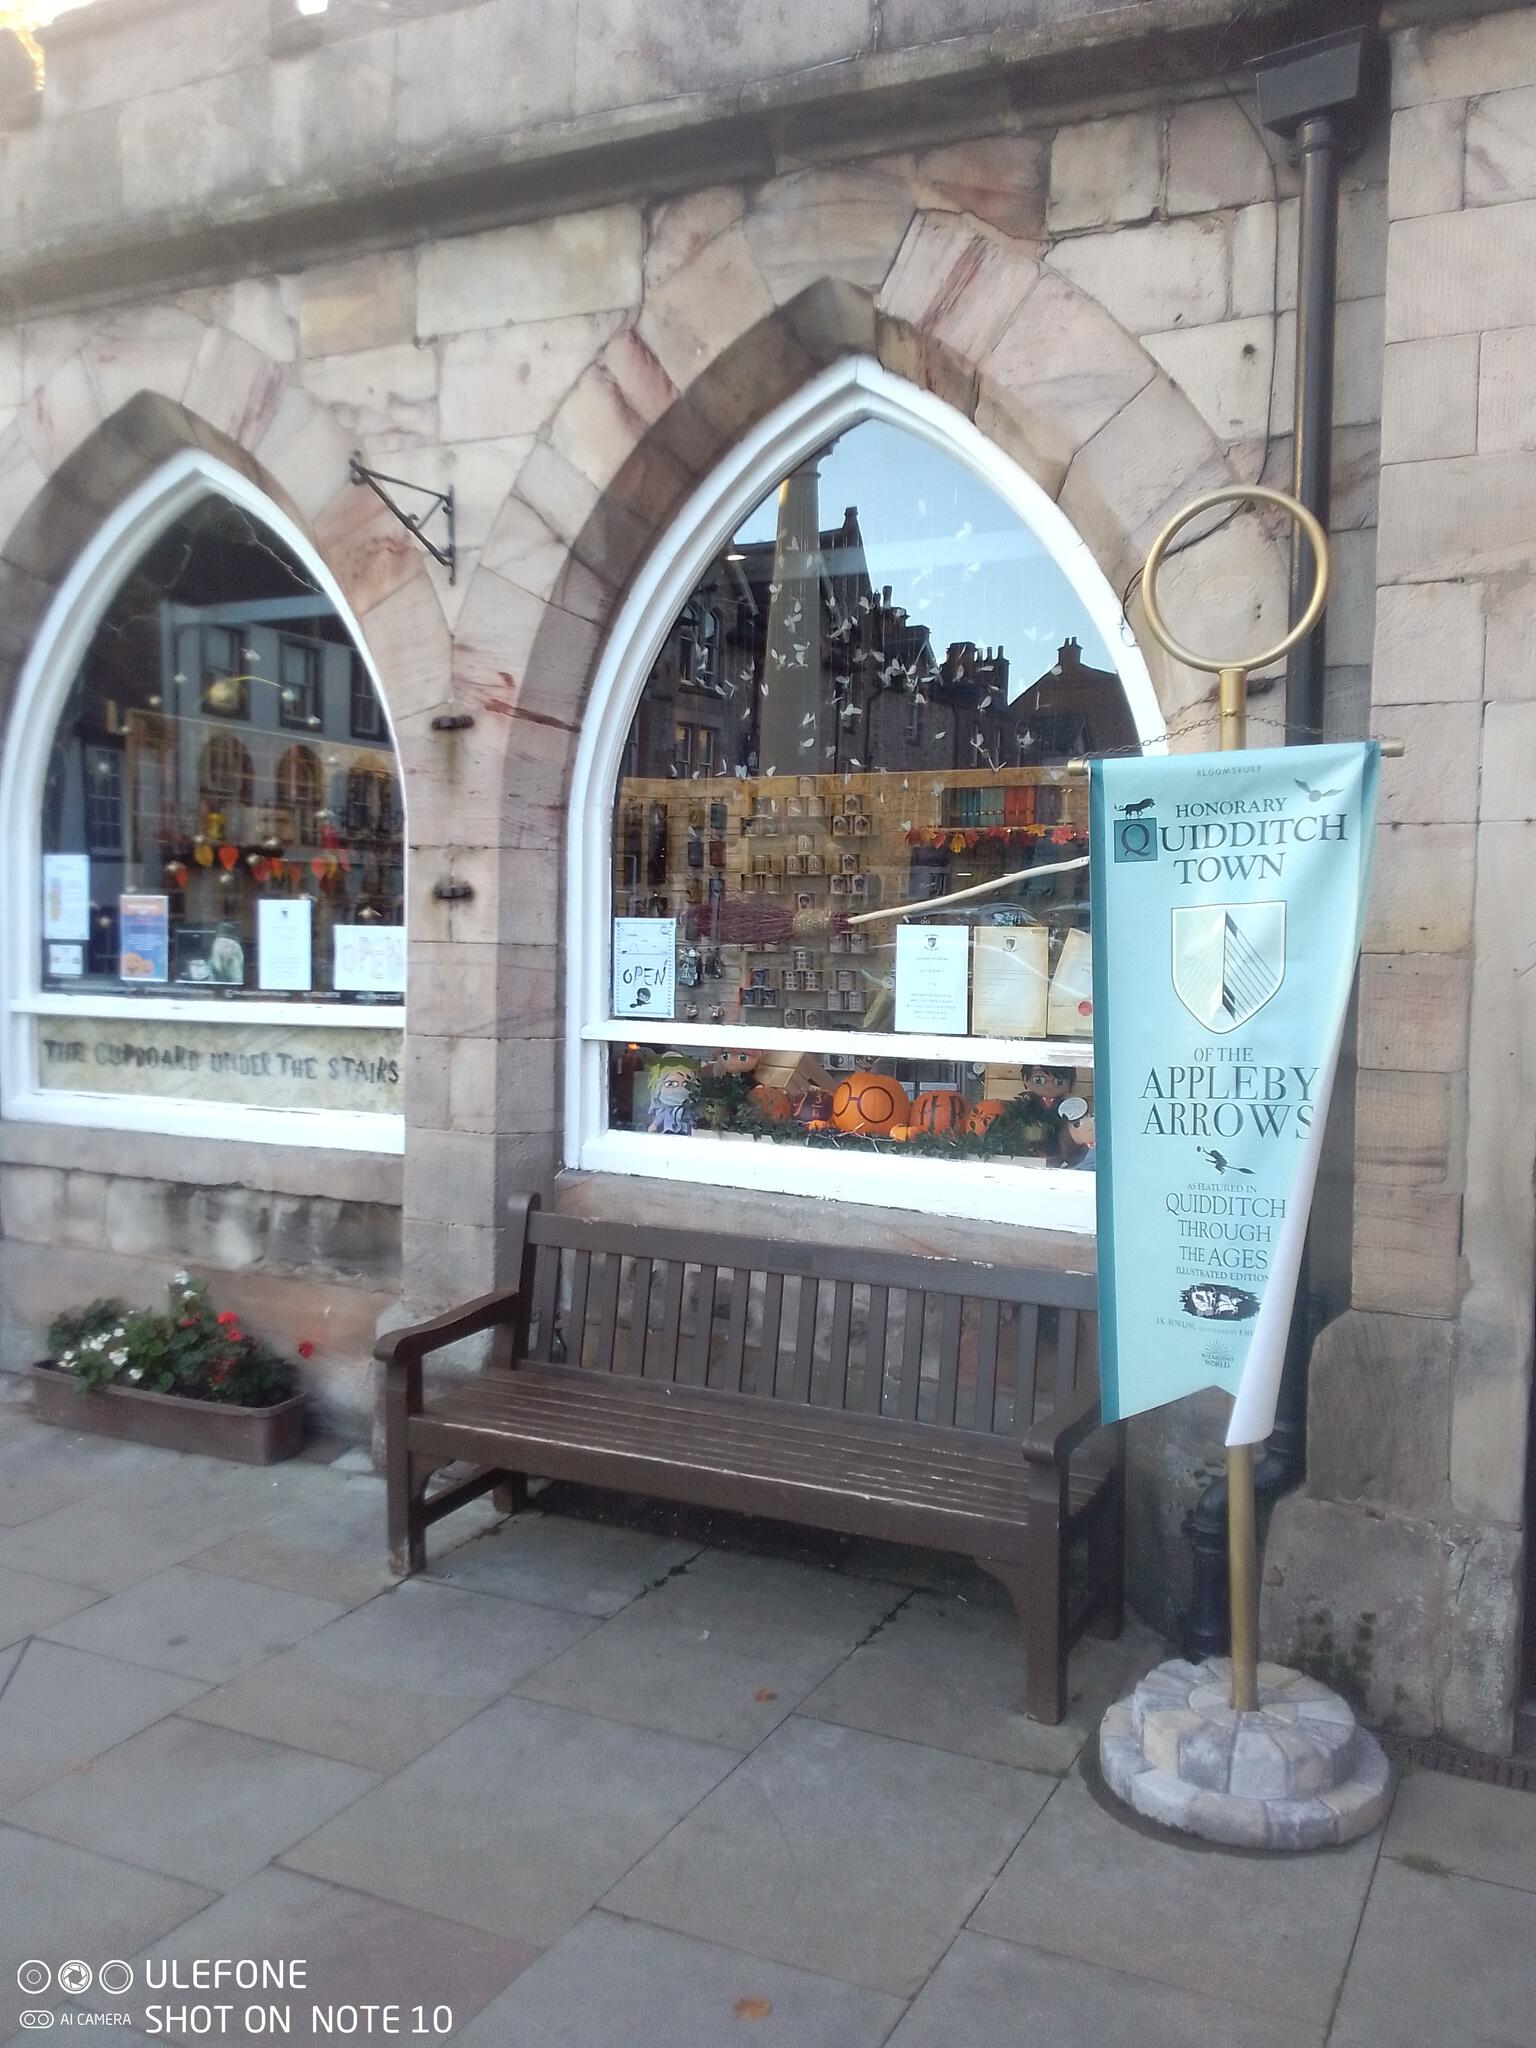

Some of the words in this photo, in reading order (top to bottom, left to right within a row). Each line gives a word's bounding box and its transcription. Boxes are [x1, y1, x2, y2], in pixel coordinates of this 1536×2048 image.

[1196, 765, 1262, 777] BLOOMSBURY
[1176, 797, 1288, 818] HONORARY
[1121, 813, 1349, 856] QUIDDITCH
[1173, 852, 1286, 885] TOWN
[622, 959, 668, 986] OPEN
[44, 1039, 86, 1063] THE
[210, 1051, 272, 1076] UNDER
[276, 1052, 318, 1080] THE
[328, 1055, 400, 1084] STAIRS
[1193, 1047, 1216, 1063] OF
[1217, 1047, 1254, 1062] THE
[1139, 1066, 1321, 1101] APPLEBY
[1141, 1102, 1314, 1140] ARROWS
[1197, 1183, 1244, 1193] FEATURED
[1246, 1185, 1258, 1193] IN
[1165, 1192, 1287, 1218] QUIDDITCH
[1177, 1219, 1272, 1243] THROUGH
[1179, 1245, 1206, 1263] THE
[1207, 1247, 1269, 1270] AGES
[1176, 1266, 1228, 1280] ILLUSTRATED
[1230, 1272, 1270, 1283] EDITION
[1204, 1359, 1231, 1369] WORLD
